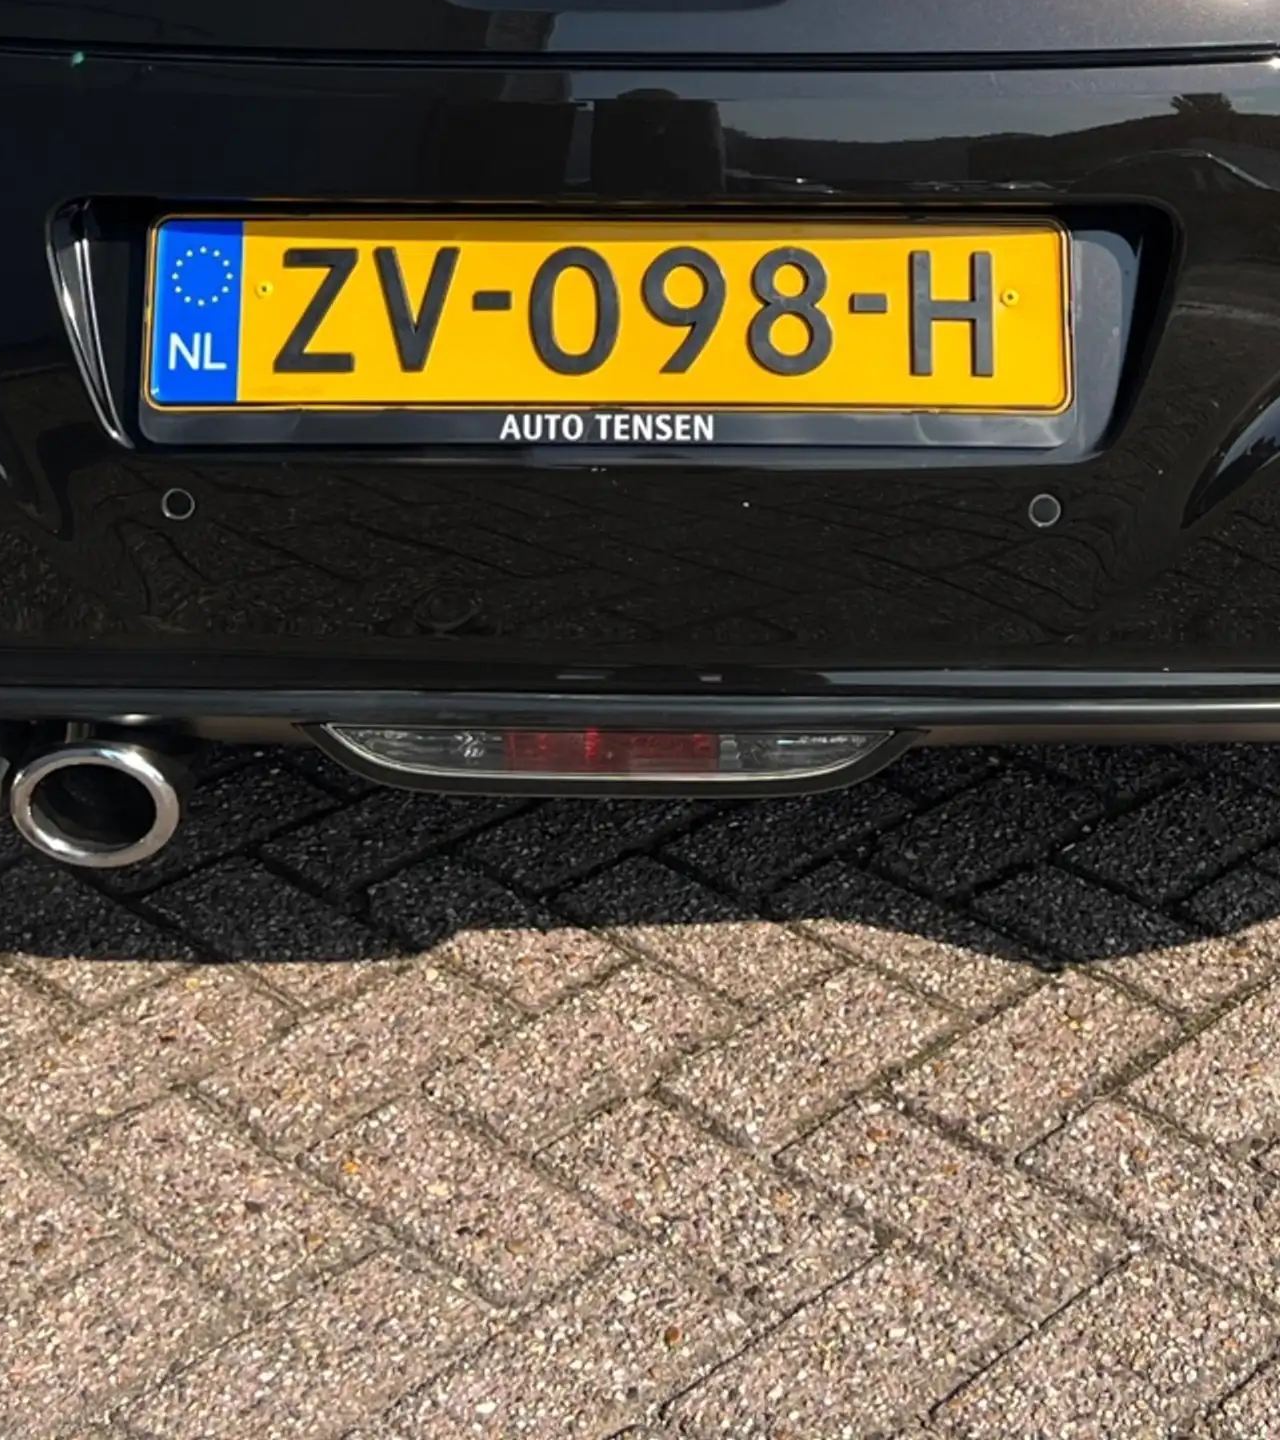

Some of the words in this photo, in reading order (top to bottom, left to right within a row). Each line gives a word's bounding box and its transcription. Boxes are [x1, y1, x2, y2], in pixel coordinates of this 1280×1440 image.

[273, 245, 995, 377] ZV-098-H
[168, 332, 228, 371] NL
[499, 413, 584, 442] AUTO
[595, 413, 715, 442] TENSEN
